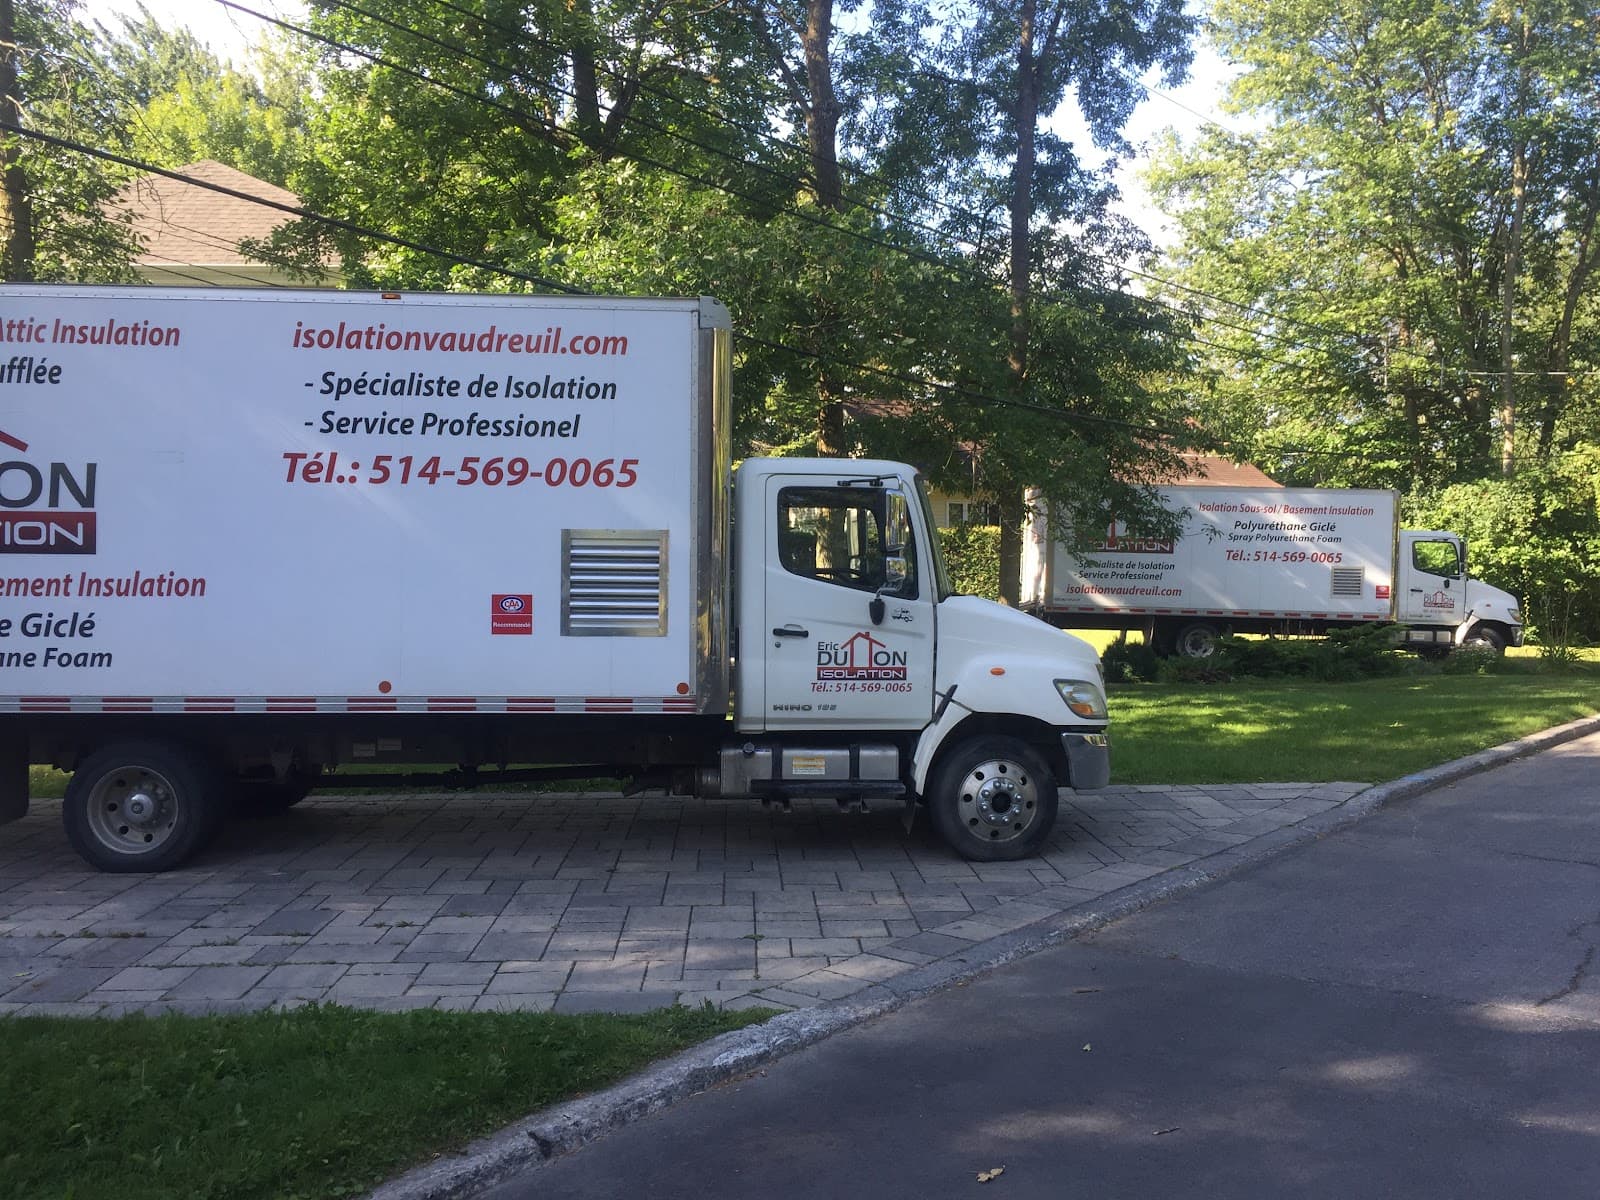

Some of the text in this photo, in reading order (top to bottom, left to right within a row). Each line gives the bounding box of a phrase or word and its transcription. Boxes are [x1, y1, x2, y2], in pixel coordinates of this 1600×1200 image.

[0, 317, 181, 346] ttic Insulation
[293, 321, 628, 356] isolationvaudreuil.com
[320, 371, 460, 400] Spécialiste
[467, 374, 498, 398] de
[504, 375, 617, 400] Isolation
[319, 410, 414, 435] Service
[421, 412, 580, 438] Professionel
[282, 452, 639, 488] Tél.: 514-569-0065
[1199, 502, 1238, 513] Isolation
[1240, 503, 1277, 514] Sous-sol
[1283, 504, 1327, 515] Basement
[1329, 506, 1374, 516] Insulation
[0, 521, 84, 546] ION
[1309, 521, 1337, 532] Giclé
[1228, 533, 1342, 544] Spray Polyurethane Foam
[1254, 551, 1342, 563] 514-569-0065
[1079, 560, 1124, 570] Spialiste
[1125, 561, 1136, 570] de
[1138, 561, 1175, 571] Isolation
[1079, 570, 1109, 580] Service
[1110, 571, 1162, 581] Professionel
[78, 571, 206, 597] Insulation
[1066, 584, 1182, 597] isolationvaudreuil.com
[20, 612, 96, 638] Giclé
[817, 641, 840, 651] Eric
[43, 647, 113, 668] Foam
[820, 669, 903, 679] ISOLATION
[835, 682, 913, 693] 514-569-0065
